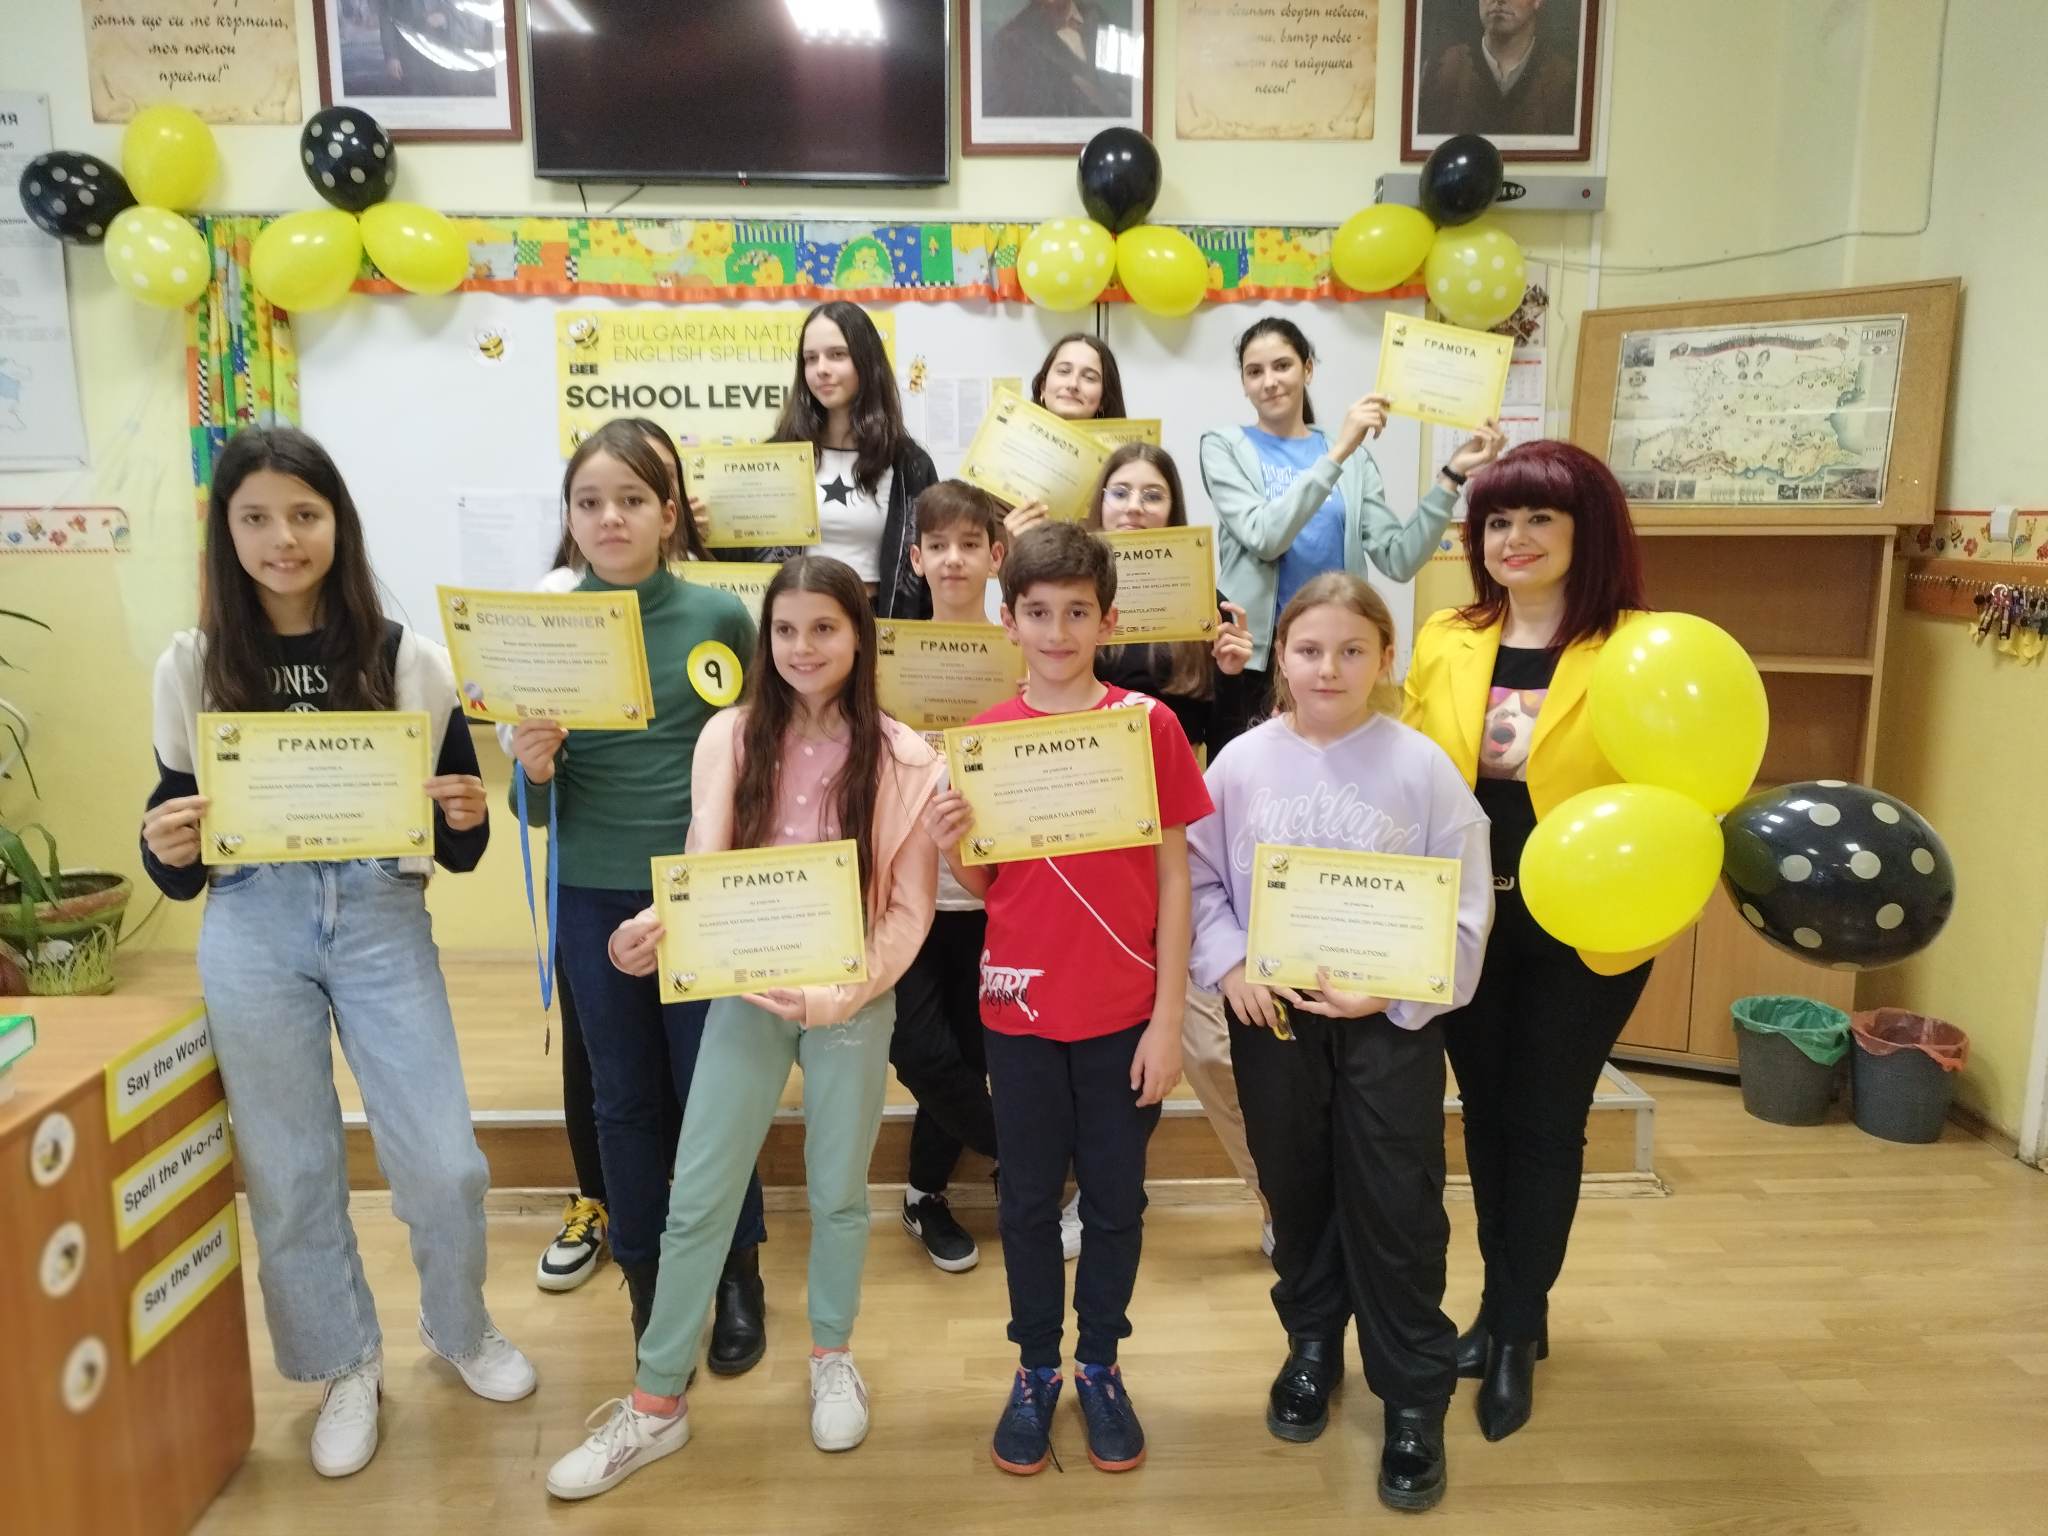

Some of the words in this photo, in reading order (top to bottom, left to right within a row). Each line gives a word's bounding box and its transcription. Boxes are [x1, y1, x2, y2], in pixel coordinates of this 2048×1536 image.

[612, 322, 737, 342] BULGARIAN
[613, 345, 704, 363] ENGLISH
[717, 345, 799, 362] SPELLIN
[1424, 338, 1477, 359] ГРАМОТА
[569, 363, 599, 376] BEE
[565, 384, 701, 409] SCHOOL
[723, 461, 782, 474] ГРАМОТА
[1114, 547, 1174, 561] РАМОТА
[476, 612, 537, 628] SCHOOL
[541, 614, 606, 630] WINNER
[920, 639, 989, 655] ГРАМОТА
[704, 660, 722, 689] 9
[277, 737, 375, 752] ГРАМОТА
[1014, 735, 1101, 758] ГРАМОТА
[722, 869, 808, 890] ГРАМОТА
[1319, 872, 1406, 892] ГРАМОТА
[126, 1069, 150, 1096] Say
[153, 1054, 173, 1079] the
[175, 1030, 208, 1063] Word
[124, 1173, 157, 1213] Spell
[158, 1157, 178, 1183] the
[181, 1122, 224, 1166] W-o-r-d
[144, 1283, 167, 1312] Say
[170, 1262, 190, 1288] the
[192, 1231, 222, 1265] Word
